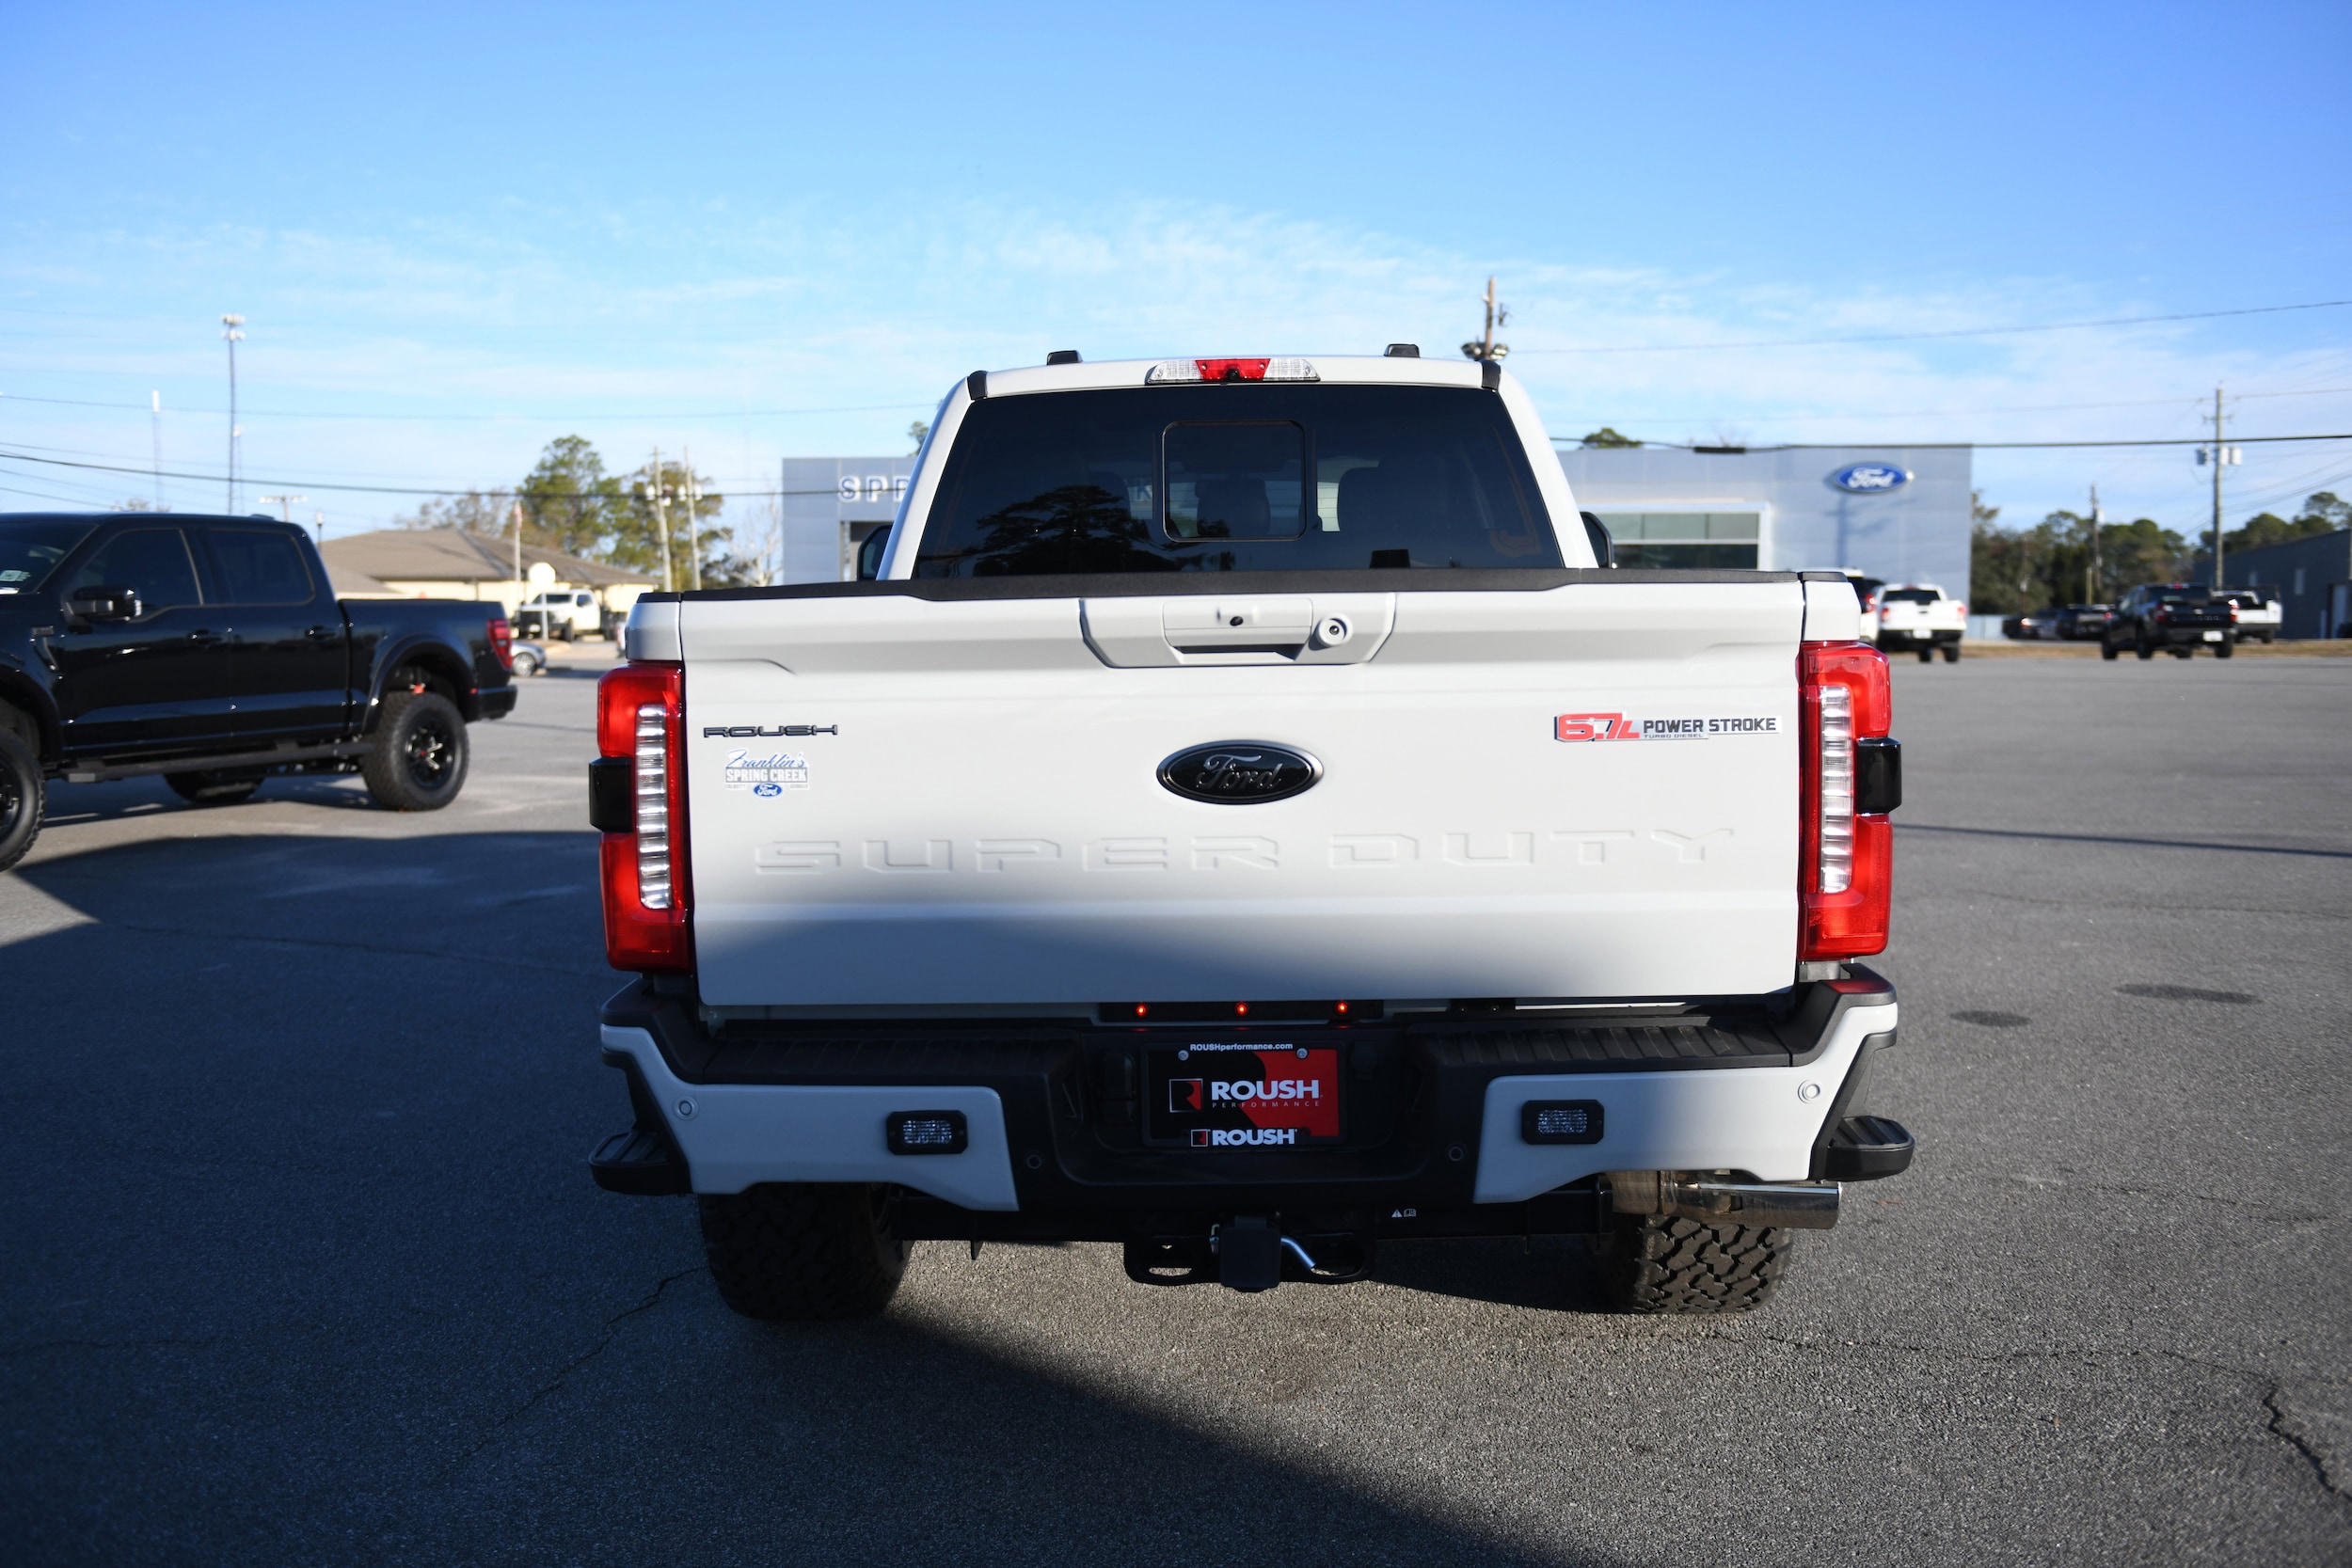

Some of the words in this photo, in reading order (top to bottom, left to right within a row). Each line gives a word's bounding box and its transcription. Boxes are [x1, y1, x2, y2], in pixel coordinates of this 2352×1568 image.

[1848, 467, 1895, 488] Ford
[704, 725, 838, 737] ROUSH
[1554, 712, 1640, 741] 6.7L
[1644, 720, 1704, 733] POWER
[1708, 718, 1777, 732] STROKE
[726, 749, 805, 768] Franklin's
[726, 768, 768, 782] SPRING
[770, 768, 806, 782] CREEK
[1196, 753, 1283, 789] Ford
[756, 784, 779, 796] Ford
[755, 835, 1279, 875] SUPER
[1328, 828, 1735, 869] DUTY
[1190, 1043, 1293, 1052] ROUSHperformance.com
[1211, 1080, 1319, 1101] ROUSH
[1212, 1129, 1295, 1146] ROUSH
